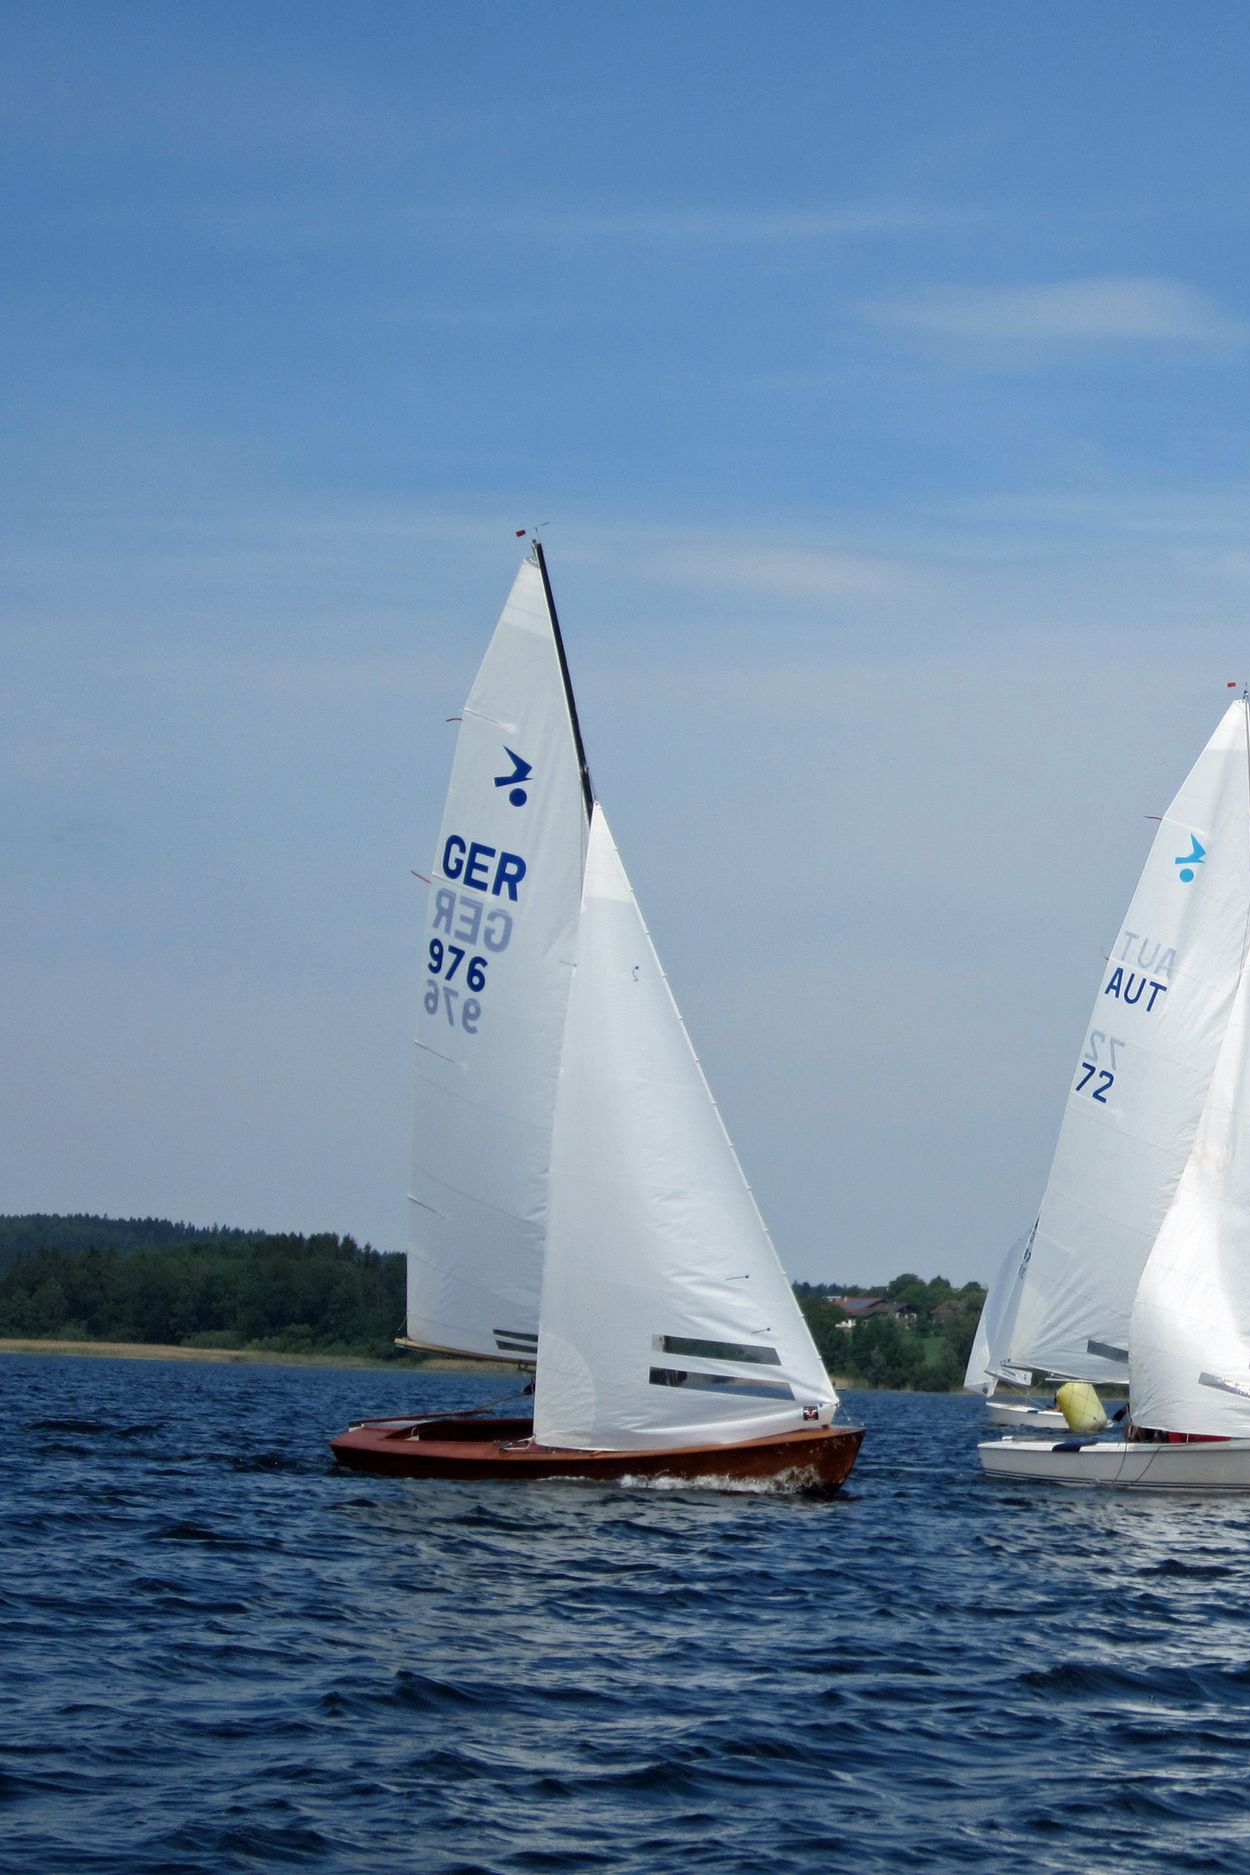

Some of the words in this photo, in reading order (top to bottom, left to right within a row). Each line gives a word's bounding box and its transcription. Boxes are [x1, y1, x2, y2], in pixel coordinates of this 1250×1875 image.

[442, 834, 527, 902] GER
[427, 938, 489, 993] 976
[1104, 966, 1168, 1012] AUT
[1075, 1061, 1115, 1104] 72
